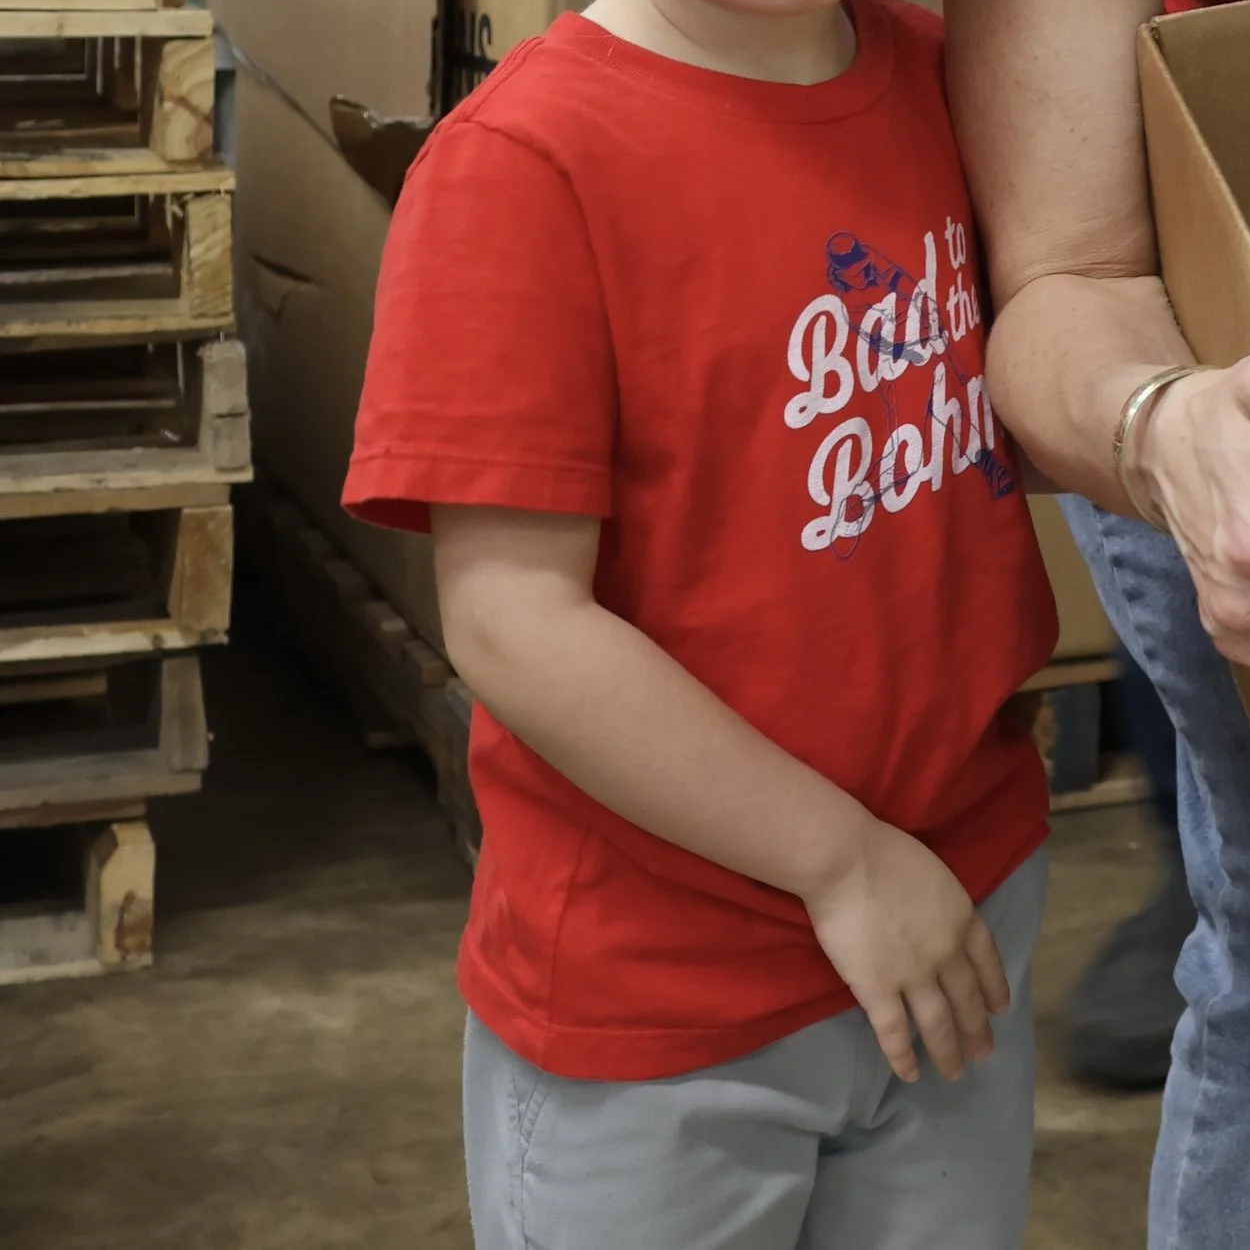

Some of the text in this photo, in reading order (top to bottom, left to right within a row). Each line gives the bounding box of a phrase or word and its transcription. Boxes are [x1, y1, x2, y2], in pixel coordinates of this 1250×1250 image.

[944, 215, 967, 270] to
[783, 230, 950, 429] Bad
[946, 272, 981, 342] the
